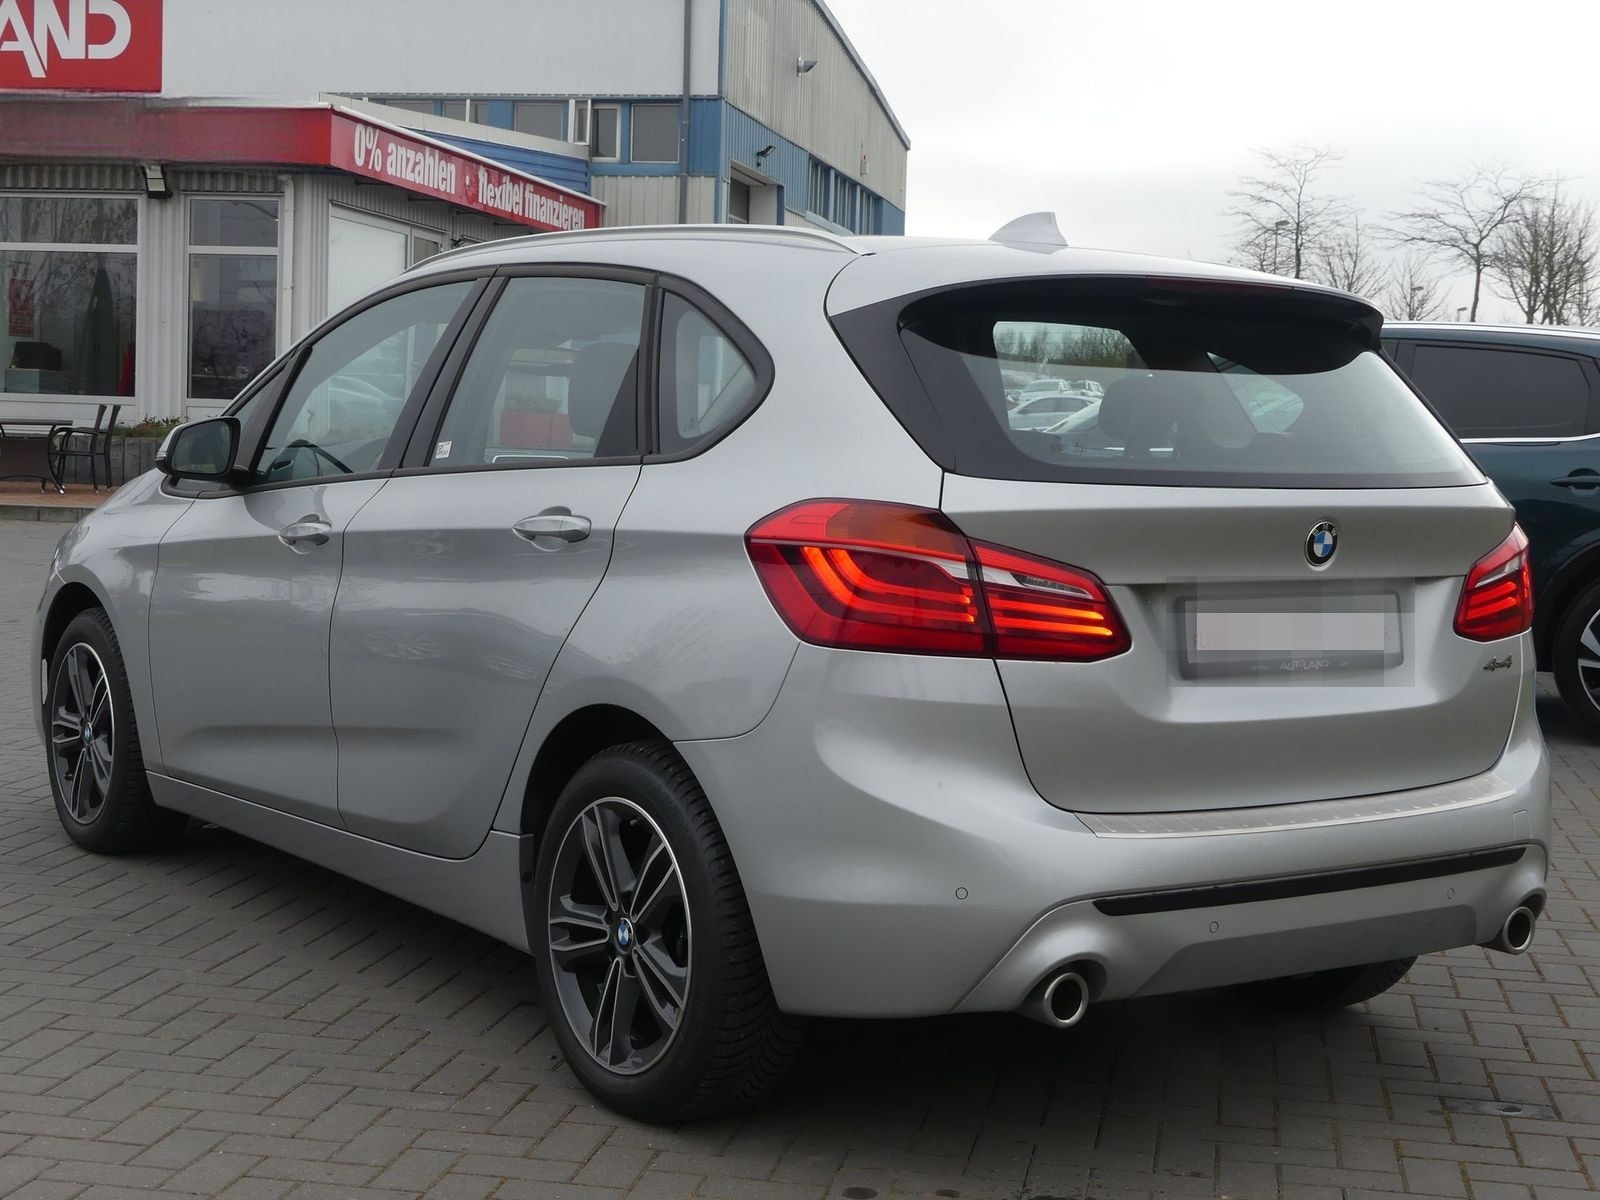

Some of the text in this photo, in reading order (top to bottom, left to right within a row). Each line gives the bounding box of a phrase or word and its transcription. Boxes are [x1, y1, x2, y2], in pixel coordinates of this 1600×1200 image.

[354, 123, 585, 231] 0% anzahlen flexibel finanzieren
